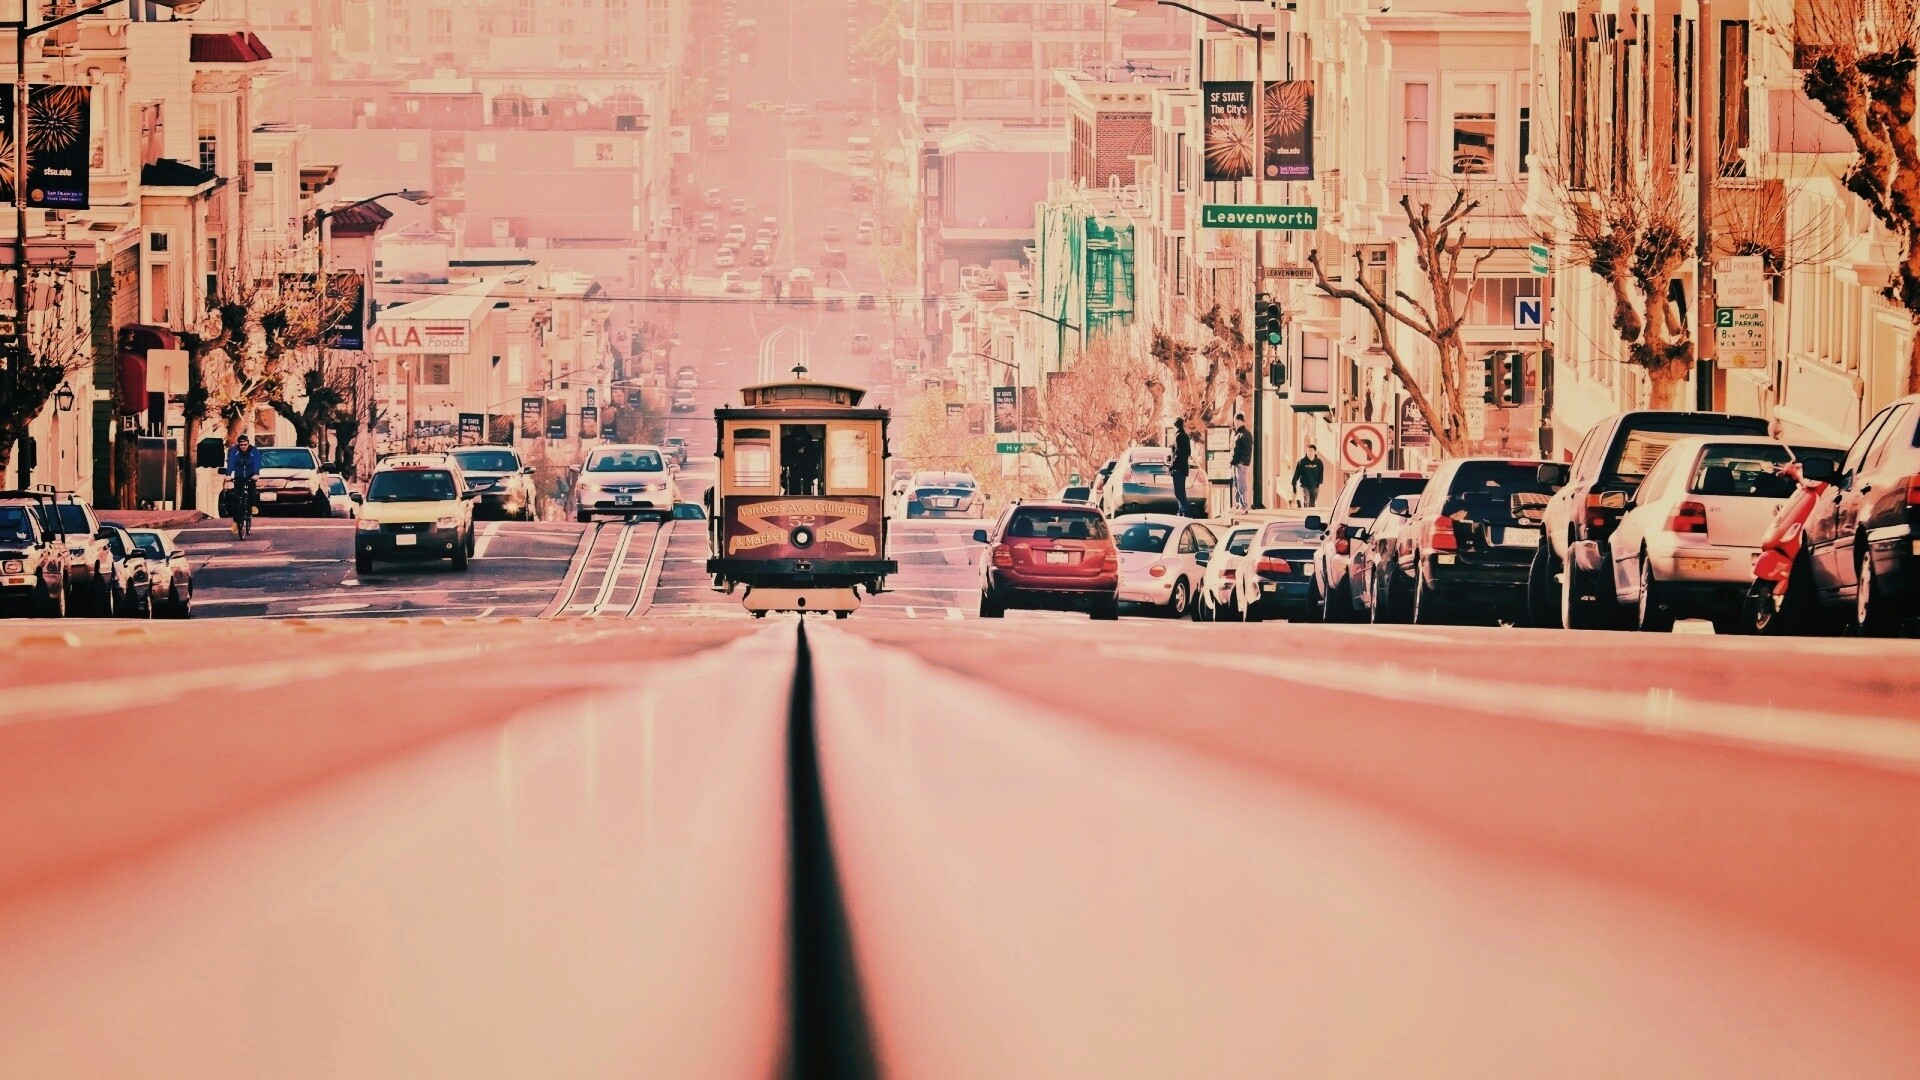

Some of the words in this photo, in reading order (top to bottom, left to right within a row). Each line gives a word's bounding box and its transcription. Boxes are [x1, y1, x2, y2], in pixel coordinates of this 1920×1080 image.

[1210, 92, 1220, 102] SF
[1222, 92, 1245, 102] STATE
[1210, 104, 1225, 114] The
[1226, 104, 1248, 116] City's
[1206, 210, 1314, 225] Leavenworth
[1719, 260, 1730, 272] NO
[1733, 261, 1761, 271] PARKING
[1266, 269, 1312, 277] LEAVENWORTH
[1727, 287, 1754, 296] MONDAY
[1520, 301, 1541, 324] N
[1720, 311, 1731, 324] 2
[428, 336, 465, 347] Foods
[740, 506, 758, 517] Van
[758, 503, 785, 515] Ness
[814, 502, 866, 517] California
[788, 515, 816, 527] 52
[734, 536, 743, 547] &
[744, 532, 783, 547] Market
[824, 529, 869, 546] Streets
